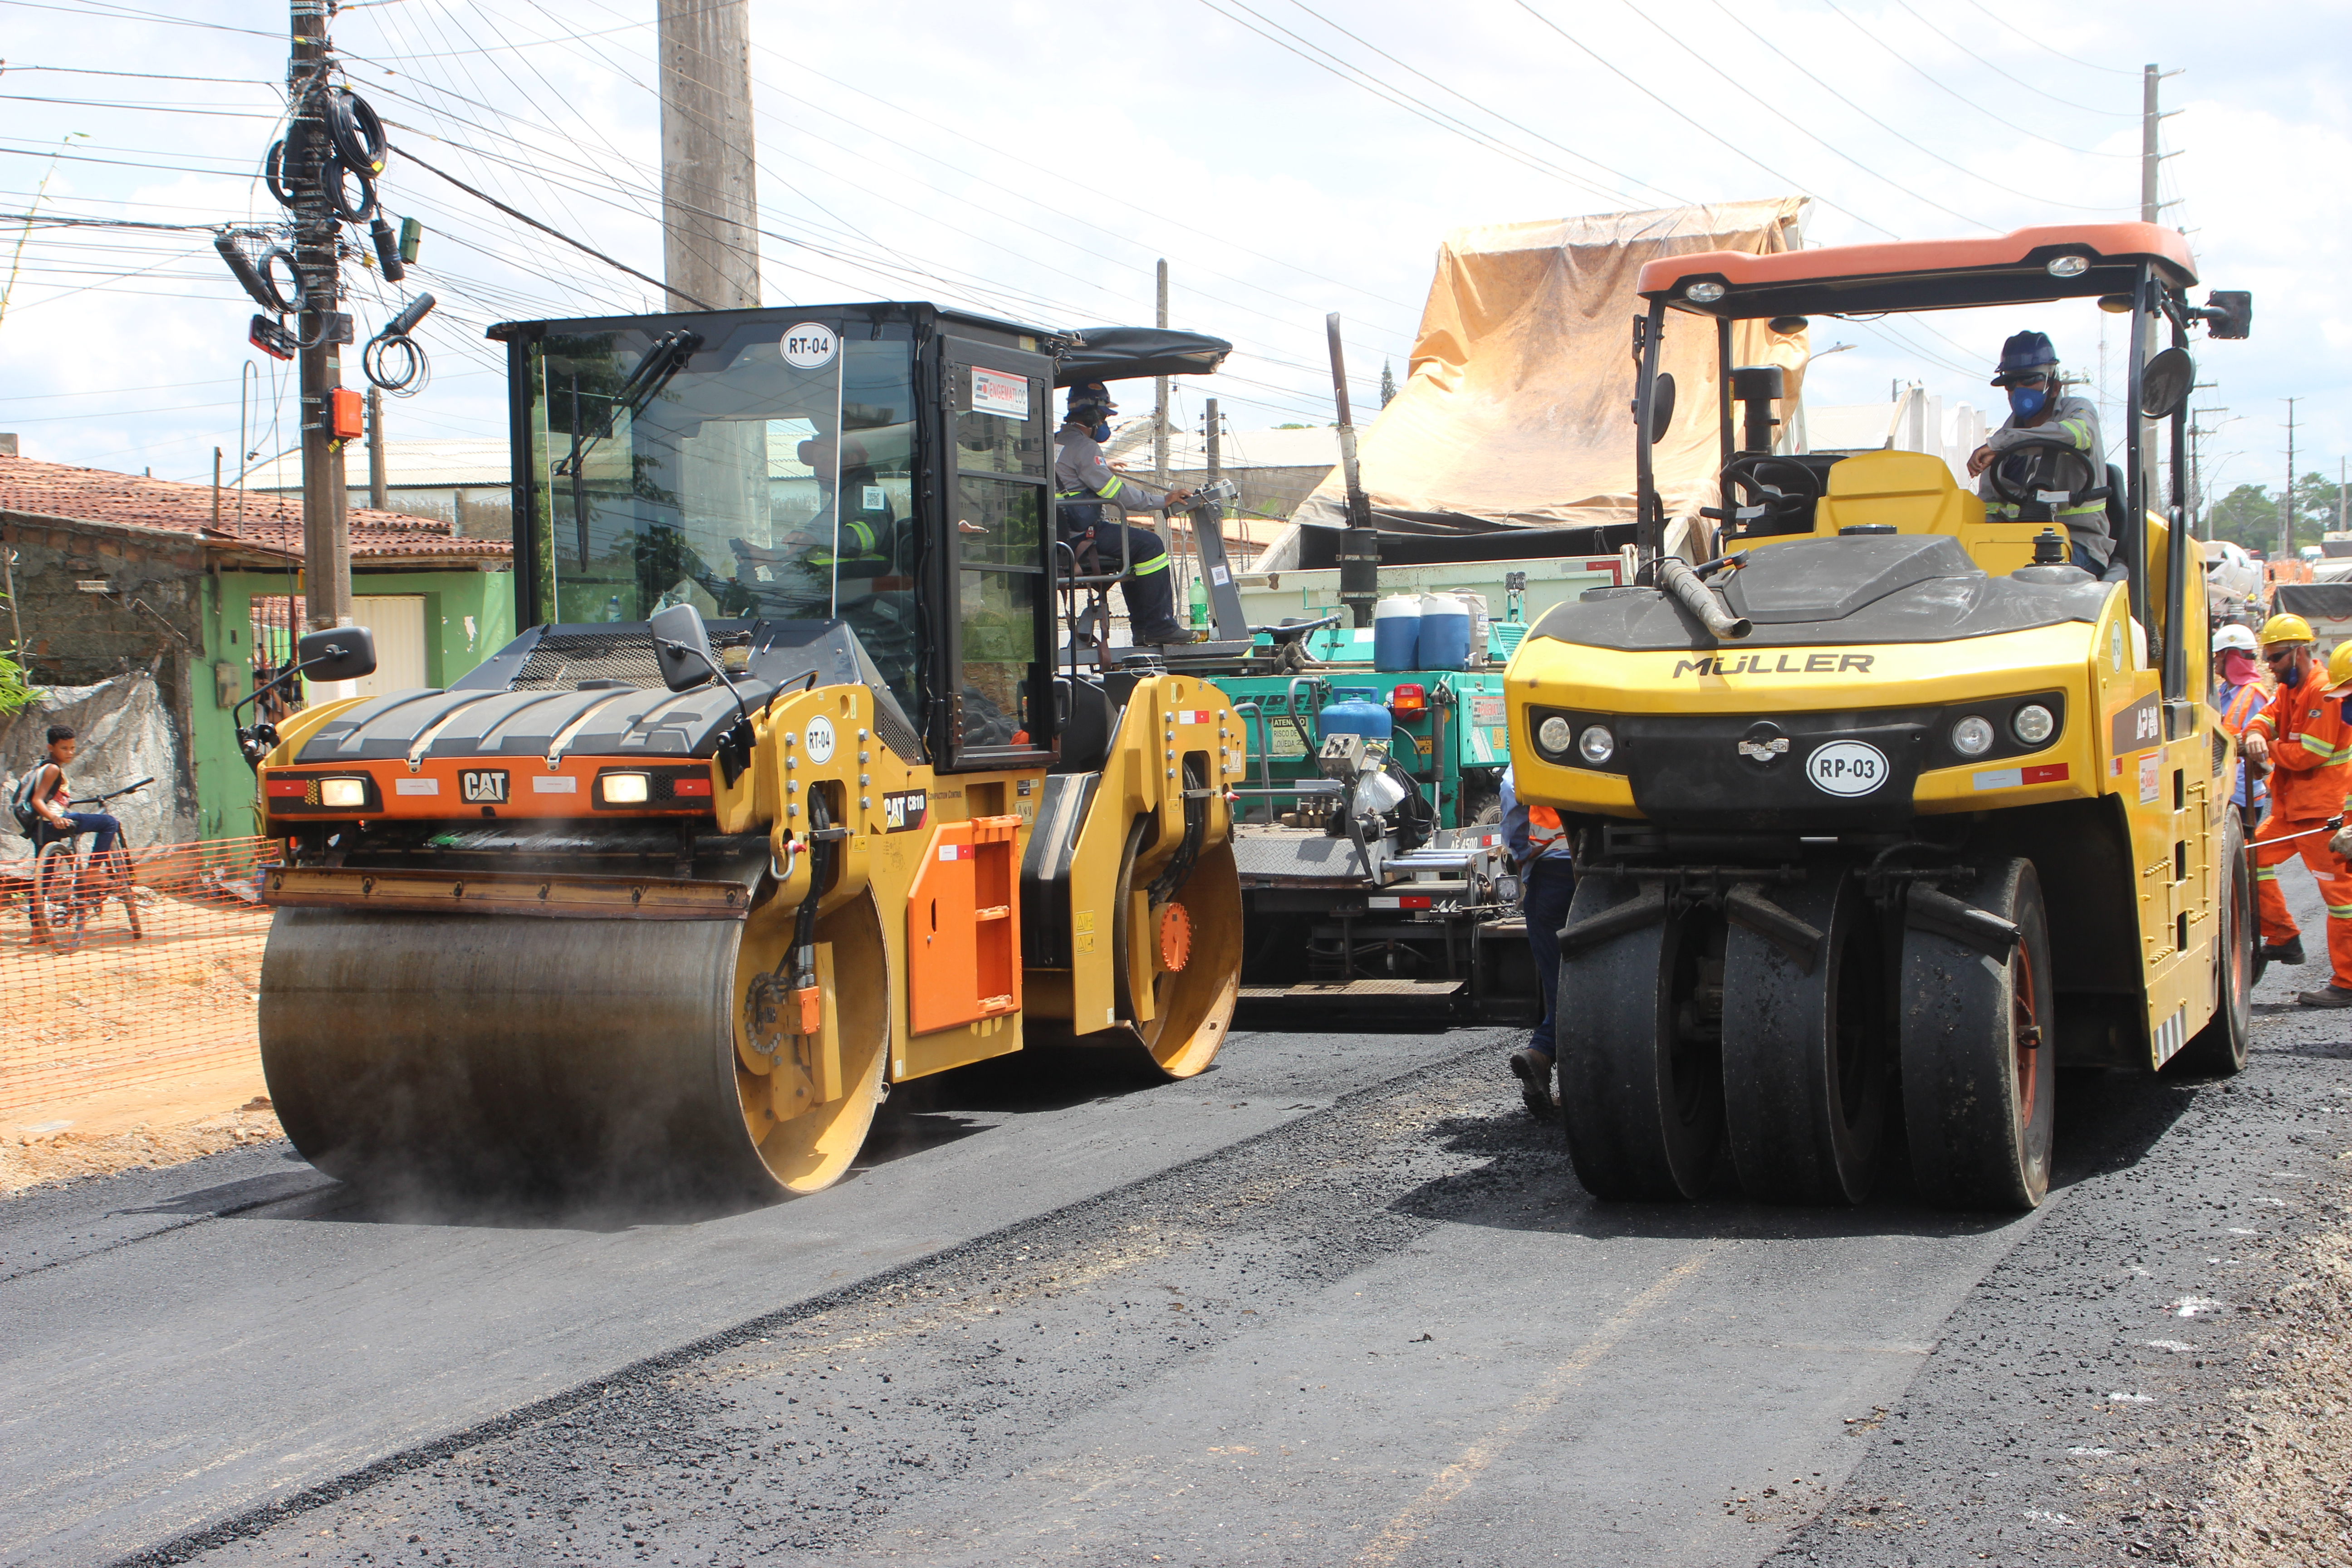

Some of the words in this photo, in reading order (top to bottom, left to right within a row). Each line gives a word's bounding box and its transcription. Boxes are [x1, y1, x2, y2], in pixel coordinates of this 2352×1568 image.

[789, 337, 828, 354] RT-04
[989, 382, 1026, 405] ENGEMATLOC
[1672, 654, 1875, 679] MÜLLER
[1274, 718, 1305, 726] ATENÇO
[809, 730, 830, 749] RT-04
[1820, 759, 1875, 779] RP-03
[464, 772, 505, 801] CAT
[883, 796, 906, 828] CAT
[907, 794, 925, 812] CB10
[1461, 836, 1478, 849] 4500
